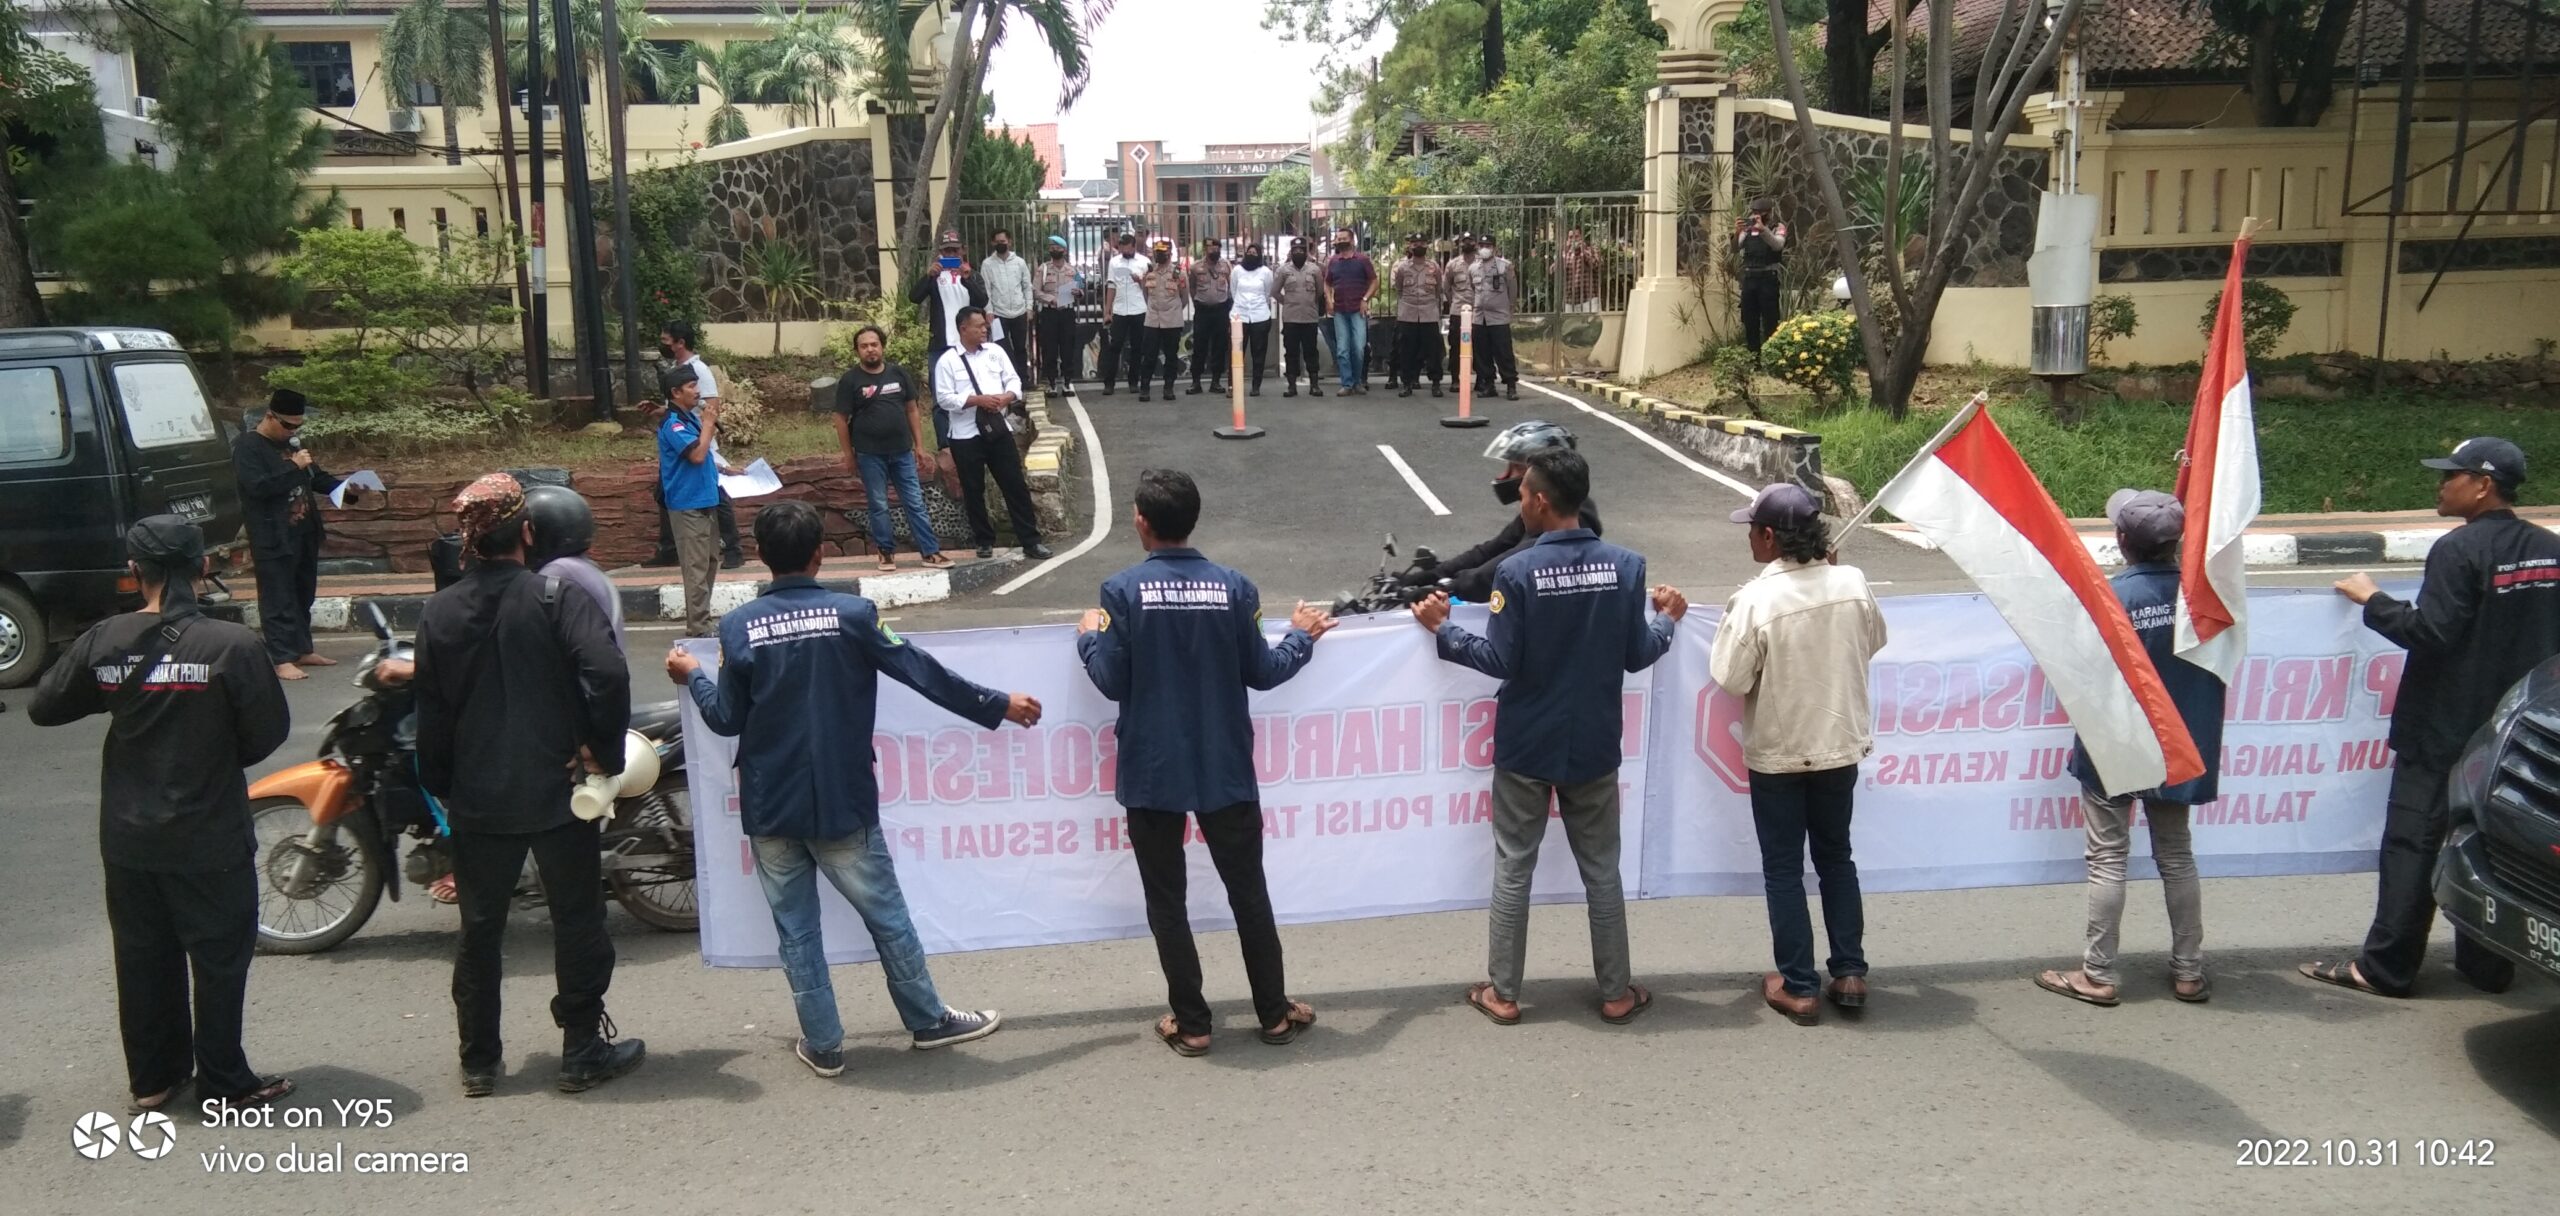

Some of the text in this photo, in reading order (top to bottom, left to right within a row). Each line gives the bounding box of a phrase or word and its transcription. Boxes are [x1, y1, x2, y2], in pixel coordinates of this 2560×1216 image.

[1534, 562, 1616, 577] KARANG TARUNA
[1140, 581, 1226, 590] KARANG TARUNA
[1536, 571, 1618, 590] DESA SUKAMANDIJAYA
[1141, 590, 1228, 604] DESA SUKAMANDIJAYA
[746, 607, 837, 628] KARANG TARUNA
[2131, 604, 2171, 620] KARANG
[747, 626, 769, 642] DESA
[770, 616, 840, 636] SUKAMANDIJAYA
[2132, 614, 2176, 631] SUKAMAN
[180, 663, 209, 683] PEDULI
[2485, 895, 2497, 924] B
